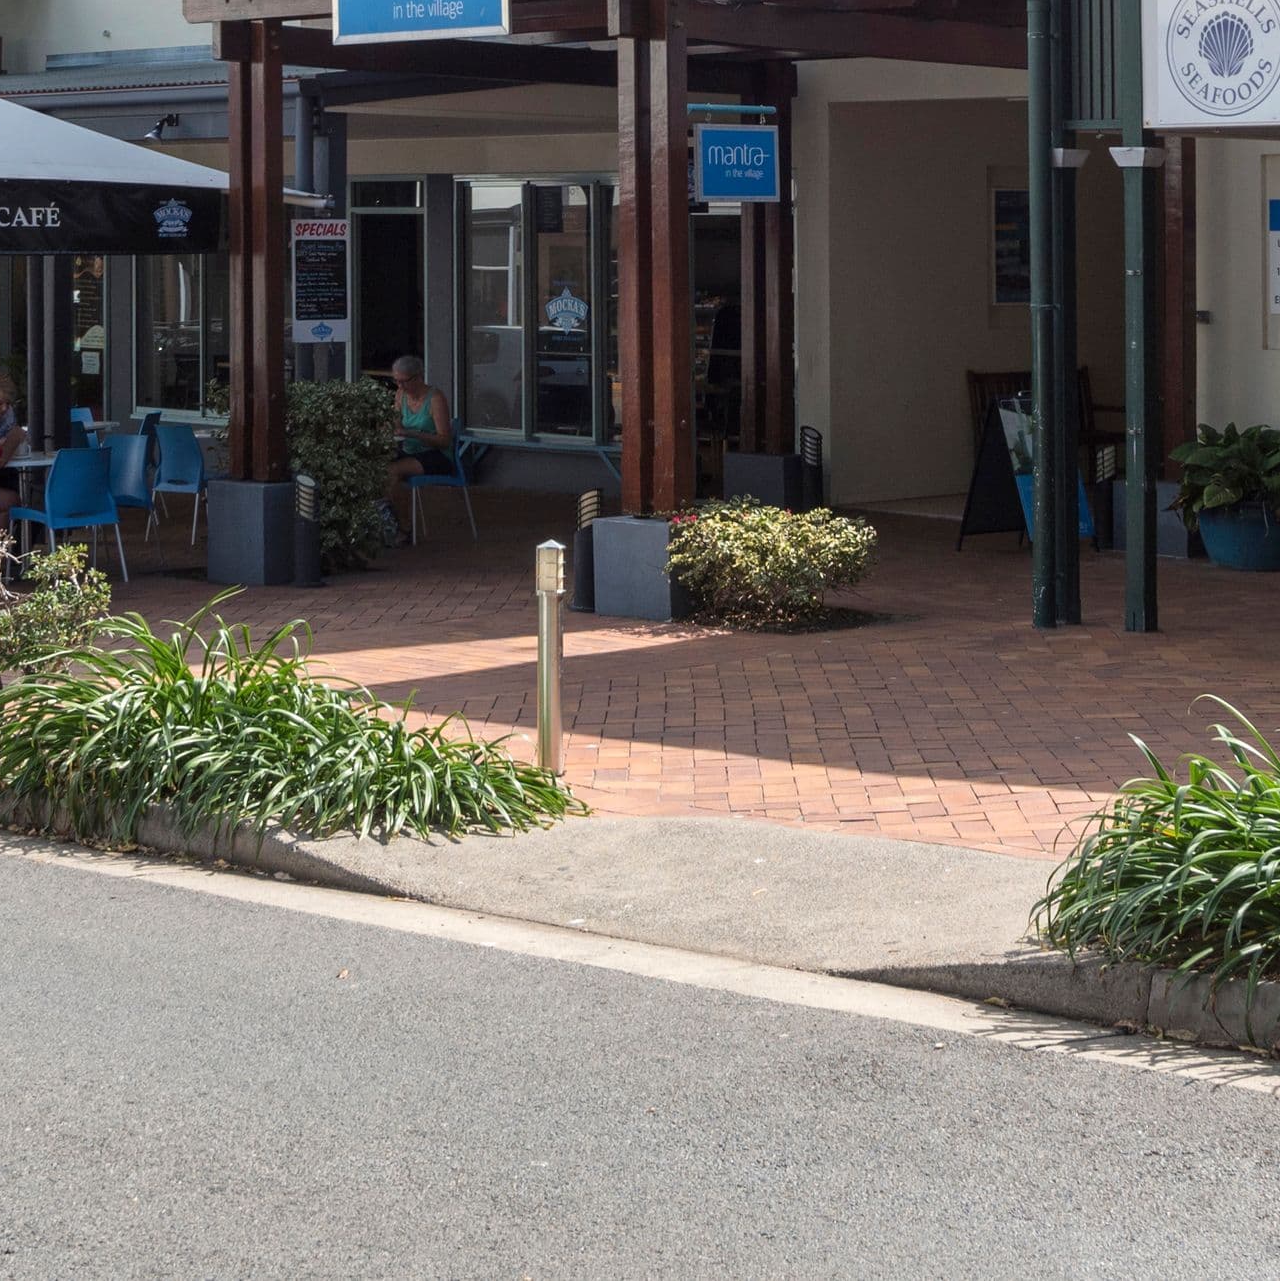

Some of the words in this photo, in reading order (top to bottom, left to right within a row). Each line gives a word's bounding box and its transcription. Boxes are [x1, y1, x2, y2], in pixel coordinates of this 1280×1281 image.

[393, 2, 403, 19] in
[406, 0, 425, 18] the
[1181, 58, 1273, 105] SEAFOODS
[708, 144, 771, 166] mantra
[745, 169, 764, 180] village
[295, 223, 347, 237] SPECIALS
